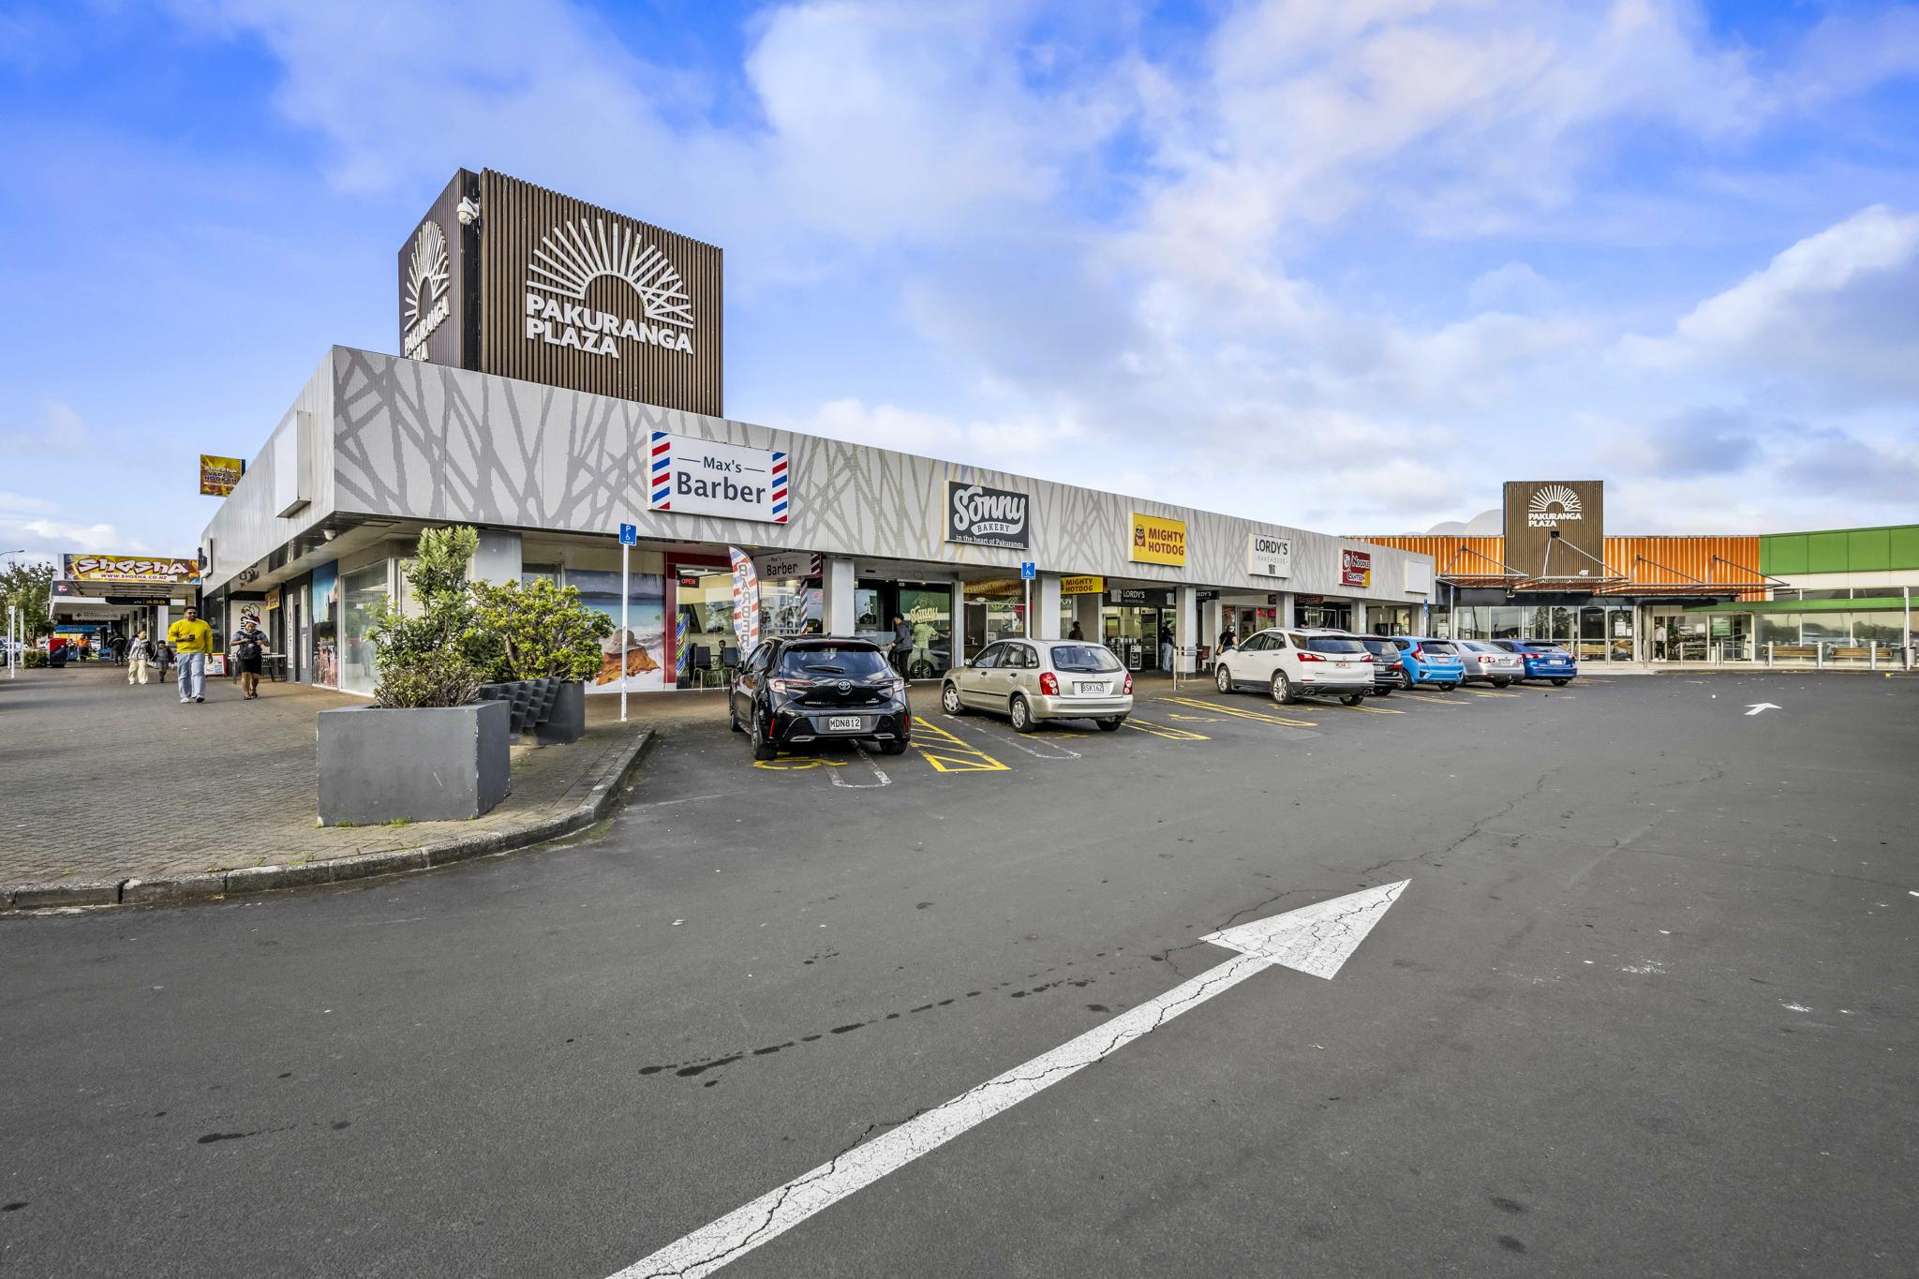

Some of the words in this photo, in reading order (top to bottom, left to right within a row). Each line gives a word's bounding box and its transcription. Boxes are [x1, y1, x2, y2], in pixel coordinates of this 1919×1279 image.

[404, 296, 450, 358] PAKURANGA
[526, 293, 694, 355] PAKURANGA
[526, 319, 620, 359] PLAZA
[703, 456, 742, 473] Max's
[677, 471, 766, 504] Barber
[953, 485, 1026, 532] Sonny
[1528, 512, 1582, 520] PAKURANGA
[977, 522, 1010, 533] BAKERY
[974, 536, 988, 544] heart
[1148, 528, 1184, 543] MIGHTY
[1148, 542, 1184, 556] HOTDOG
[1255, 538, 1288, 555] LORDY'S
[766, 562, 798, 576] Barber
[681, 577, 696, 585] OPEN
[1065, 578, 1093, 586] MIGHTY
[1123, 590, 1145, 599] LORDY'S
[830, 719, 860, 728] MDN812
